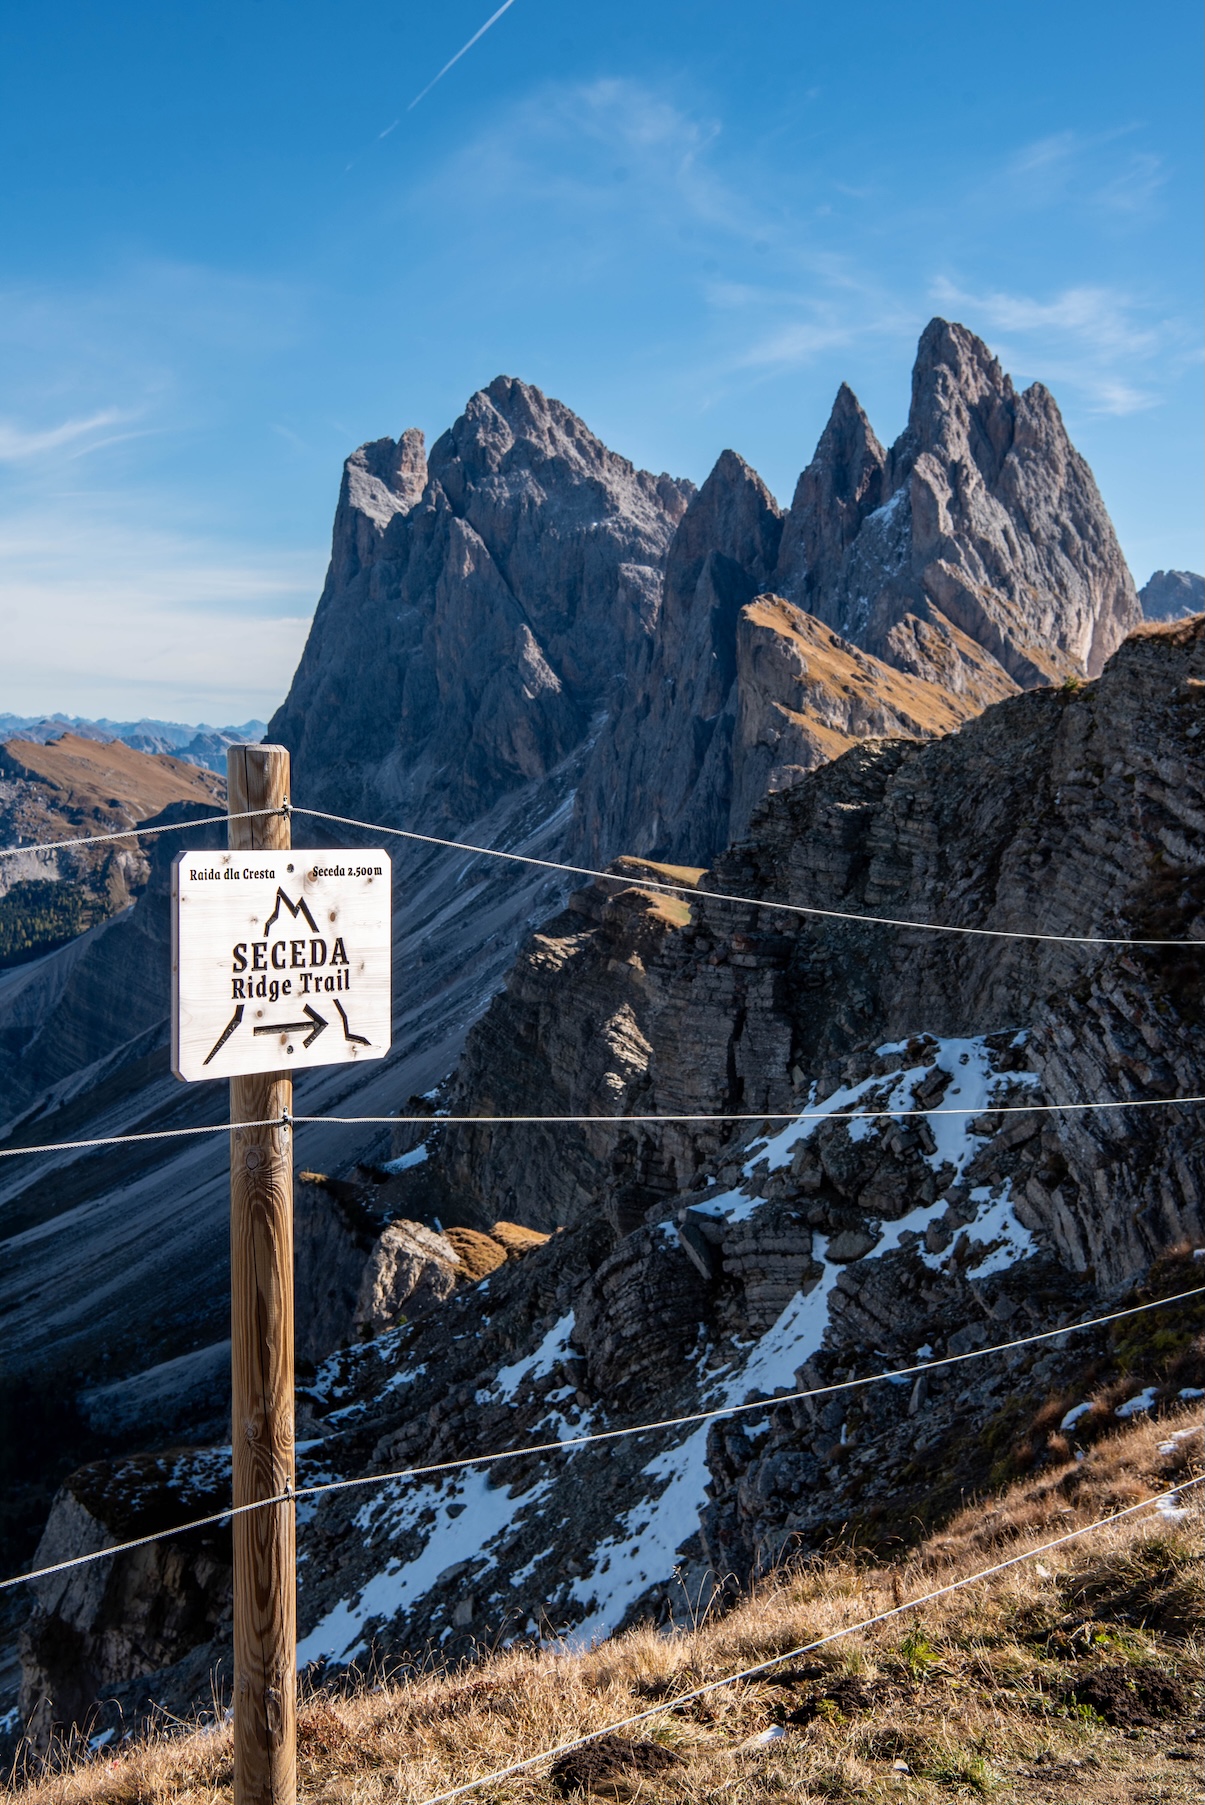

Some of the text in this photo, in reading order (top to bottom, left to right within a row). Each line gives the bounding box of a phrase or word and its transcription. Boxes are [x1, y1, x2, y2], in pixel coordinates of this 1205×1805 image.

[190, 868, 275, 881] Raida dla Cresta
[312, 865, 345, 877] Seceda
[232, 937, 350, 973] SECEDA
[231, 968, 350, 1002] Ridge Trail
